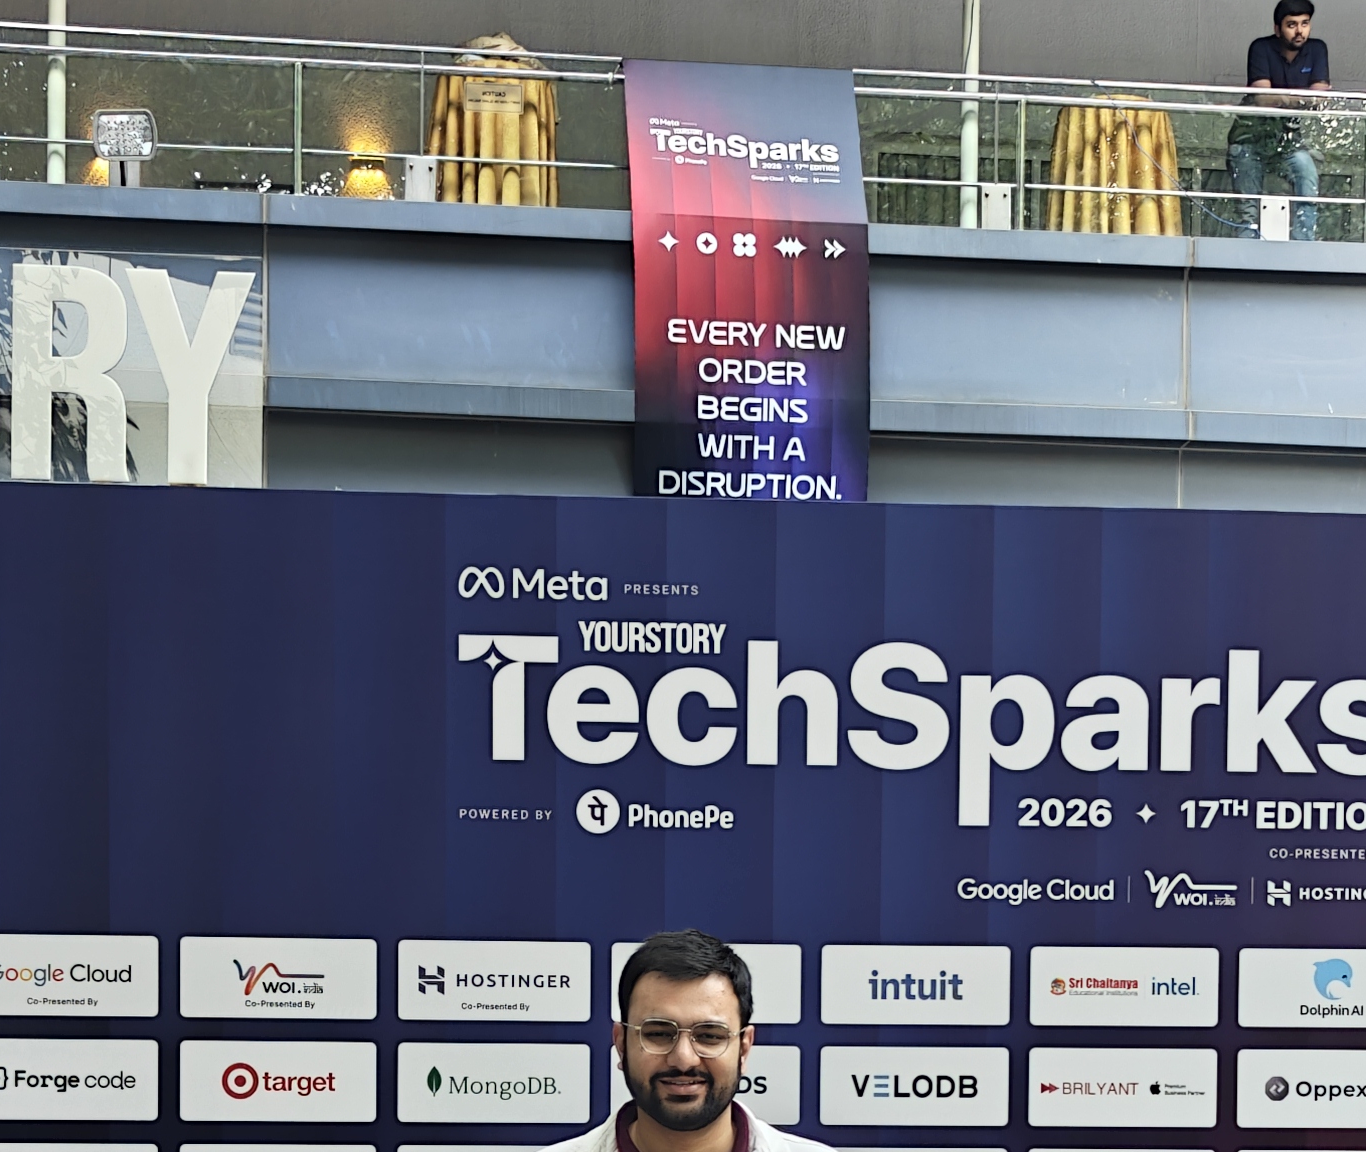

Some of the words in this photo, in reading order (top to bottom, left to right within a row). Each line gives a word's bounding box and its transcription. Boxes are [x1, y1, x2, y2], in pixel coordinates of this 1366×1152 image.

[649, 129, 840, 169] TechSparks
[667, 318, 767, 348] EVERY
[775, 325, 845, 350] NEW
[698, 357, 807, 387] ORDER
[697, 394, 809, 423] BEGINS
[698, 432, 775, 461] WITH
[783, 436, 806, 462] A
[659, 470, 843, 500] DISRUPTION.
[512, 568, 609, 601] Meta
[623, 584, 699, 596] PRESENTS
[578, 620, 727, 654] YOURSTORY
[459, 808, 529, 820] POWERED
[535, 809, 553, 821] BY
[628, 803, 735, 829] PhonePe
[1017, 797, 1113, 828] 2026
[1180, 799, 1249, 829] 17TH
[957, 877, 1042, 906] Google
[1047, 878, 1115, 901] Cloud
[69, 964, 133, 984] Cloud
[456, 974, 571, 990] HOSTINGER
[869, 970, 963, 1001] intuit
[1069, 977, 1083, 989] Sri
[1085, 977, 1139, 990] Chaitanya
[27, 997, 85, 1006] Co-Presented
[87, 998, 99, 1006] By
[461, 1002, 517, 1012] Co-Presented
[519, 1002, 531, 1012] By
[13, 1070, 81, 1092] Forge
[84, 1072, 136, 1090] code
[263, 1072, 335, 1096] target
[851, 1074, 978, 1098] VELODB
[1062, 1082, 1139, 1096] BRILYANT
